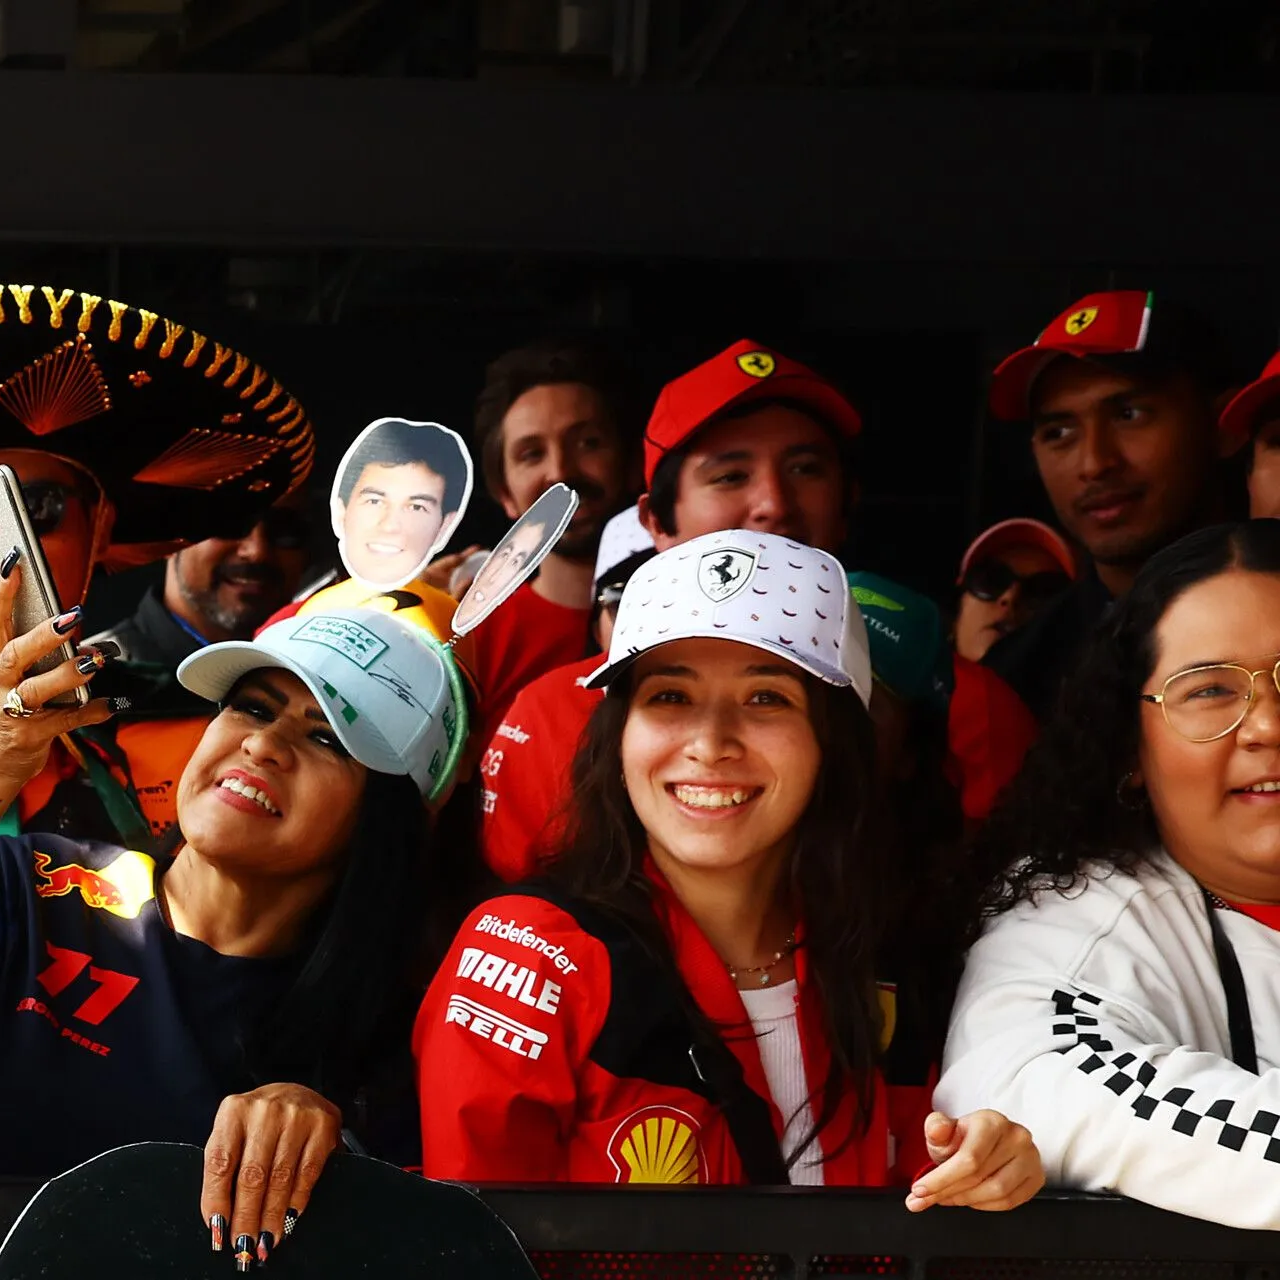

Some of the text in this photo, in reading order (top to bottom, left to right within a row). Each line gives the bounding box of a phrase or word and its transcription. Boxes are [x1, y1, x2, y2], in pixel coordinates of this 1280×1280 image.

[315, 620, 378, 647] ORACLE
[869, 616, 901, 643] TEAM
[475, 914, 579, 975] Bitdefender
[36, 940, 140, 1025] 11
[456, 947, 563, 1015] MAHLE
